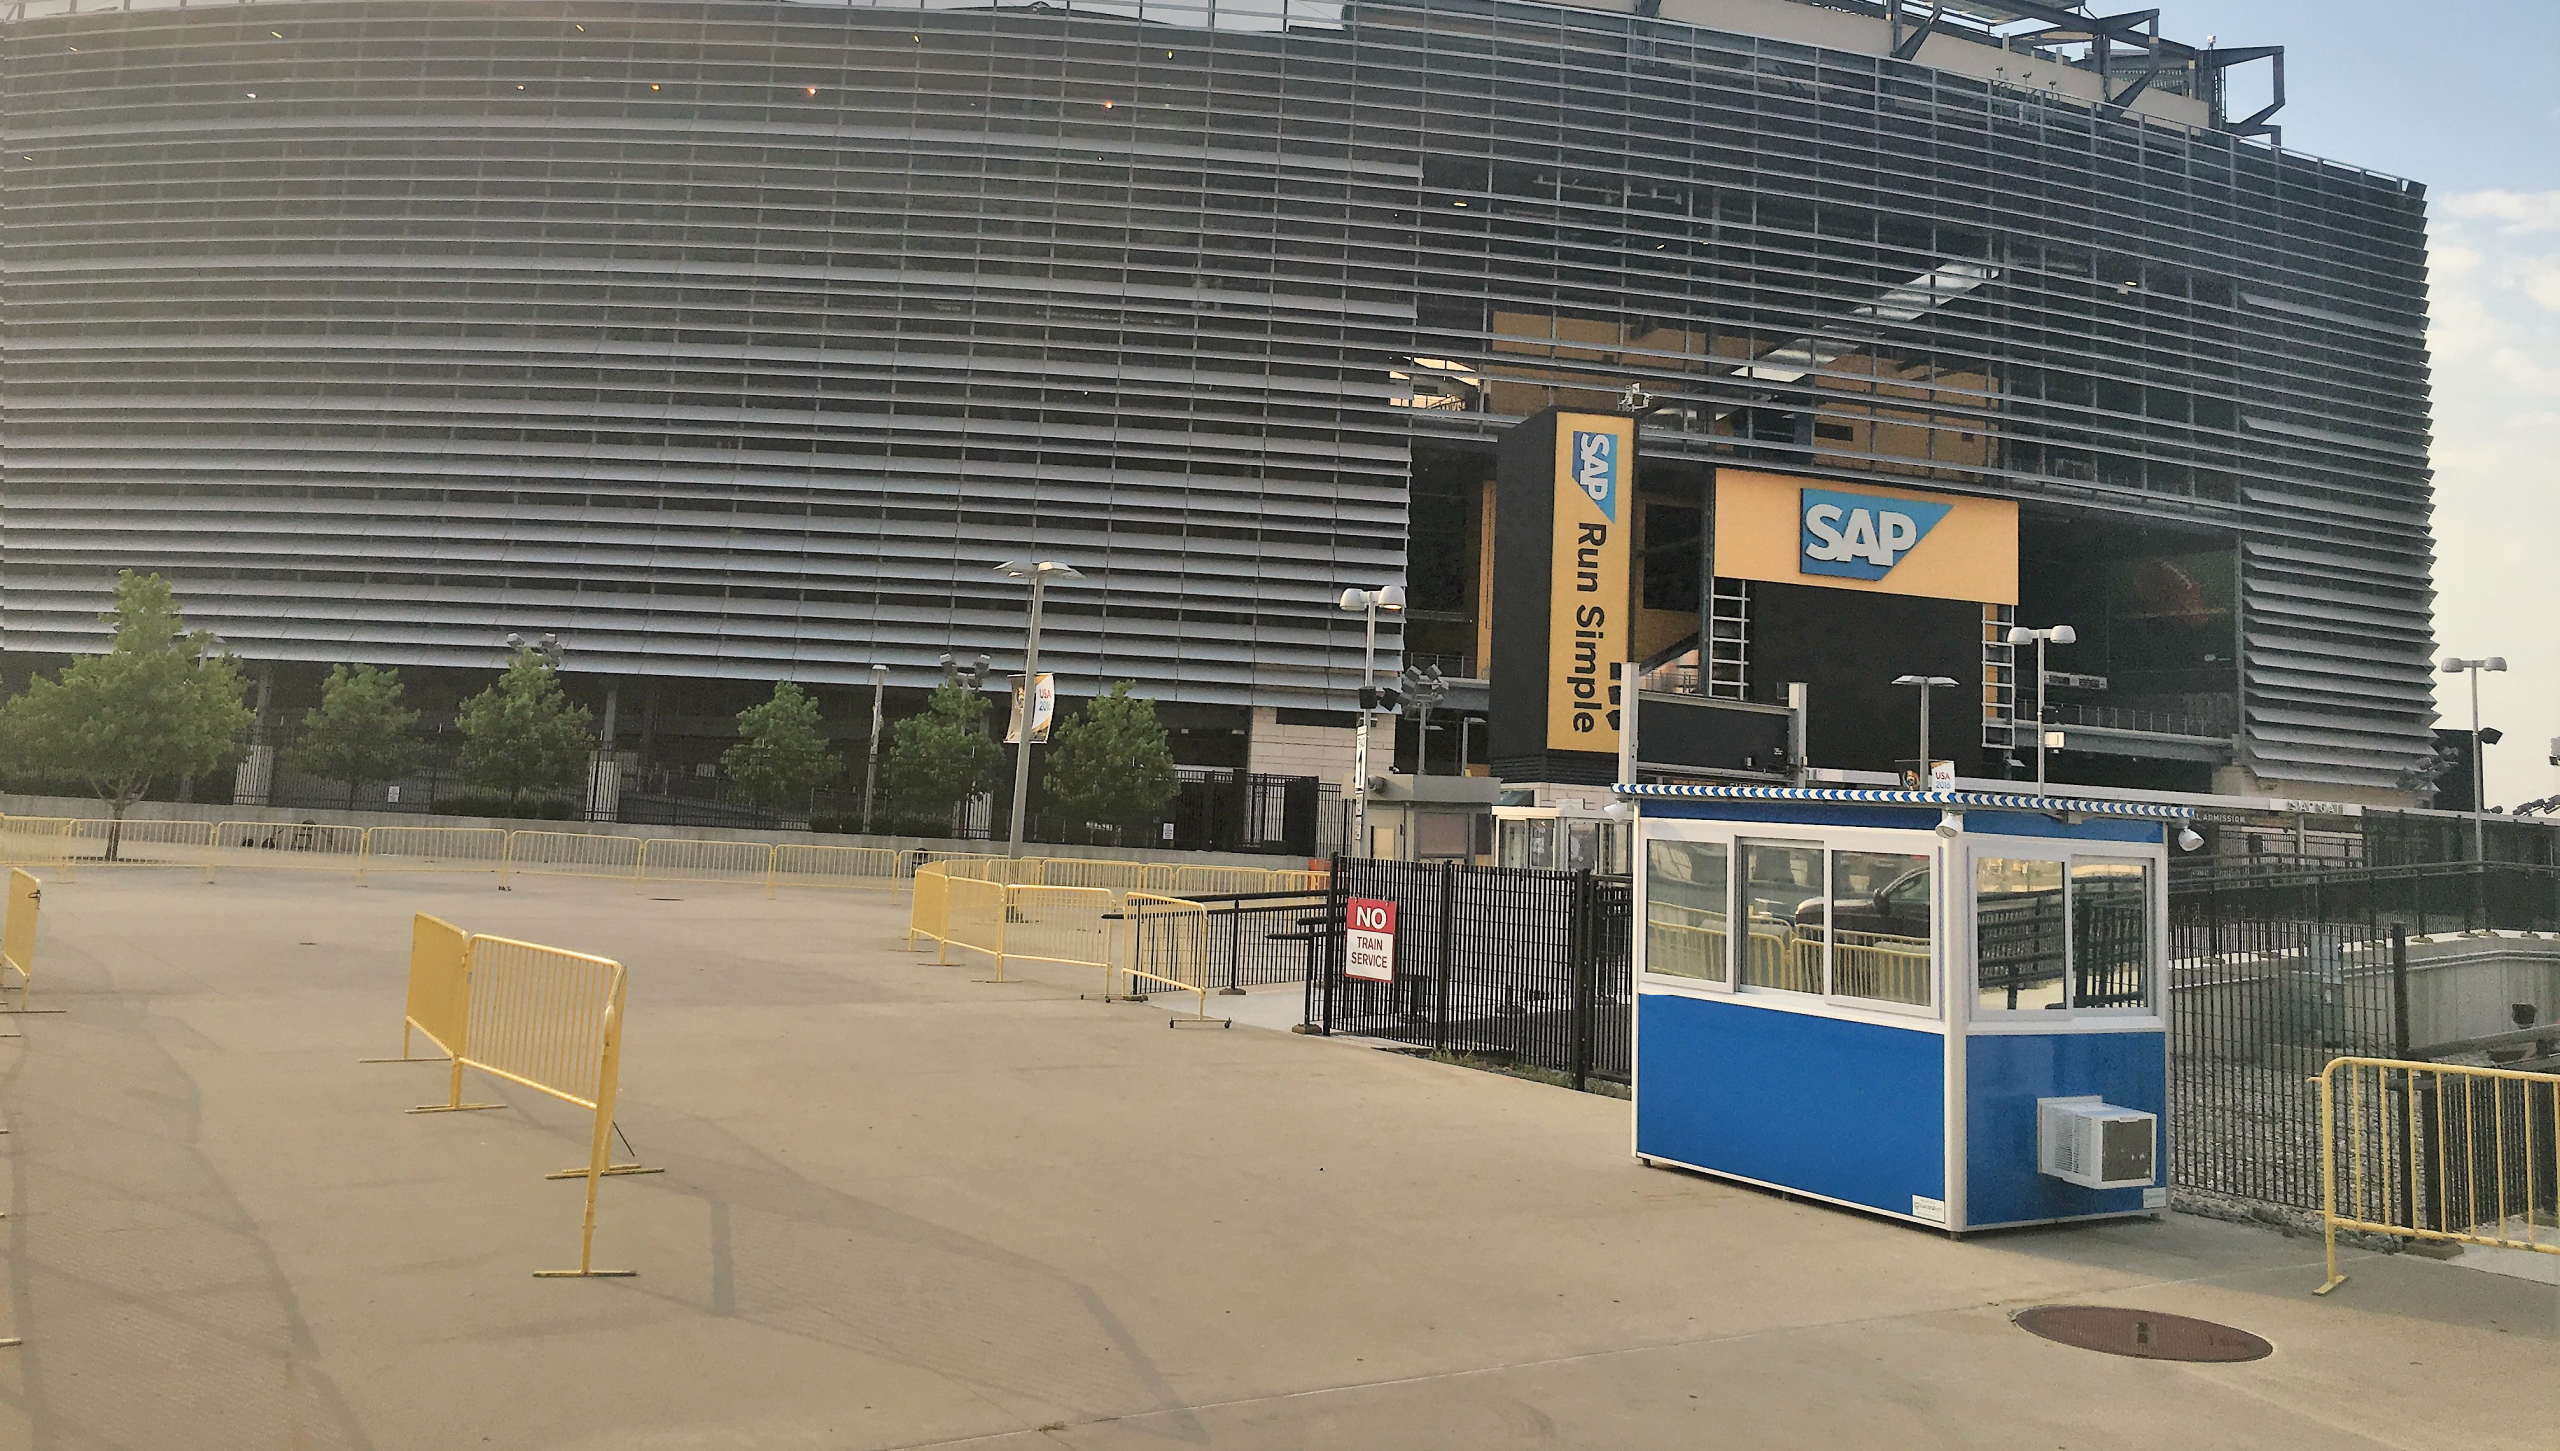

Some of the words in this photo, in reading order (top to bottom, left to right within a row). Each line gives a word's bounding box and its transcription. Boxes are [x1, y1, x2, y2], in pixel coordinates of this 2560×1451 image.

[1580, 432, 1610, 501] SAP
[1805, 503, 1917, 567] SAP
[1577, 522, 1607, 593] Run
[1566, 604, 1605, 733] Simple
[1039, 689, 1051, 699] USA
[1935, 771, 1951, 780] USA
[1935, 781, 1951, 790] 2016
[2202, 813, 2246, 823] ADMISSION
[1356, 906, 1387, 930] NO
[1357, 936, 1383, 951] TRAIN
[1351, 951, 1388, 968] SERVICE
